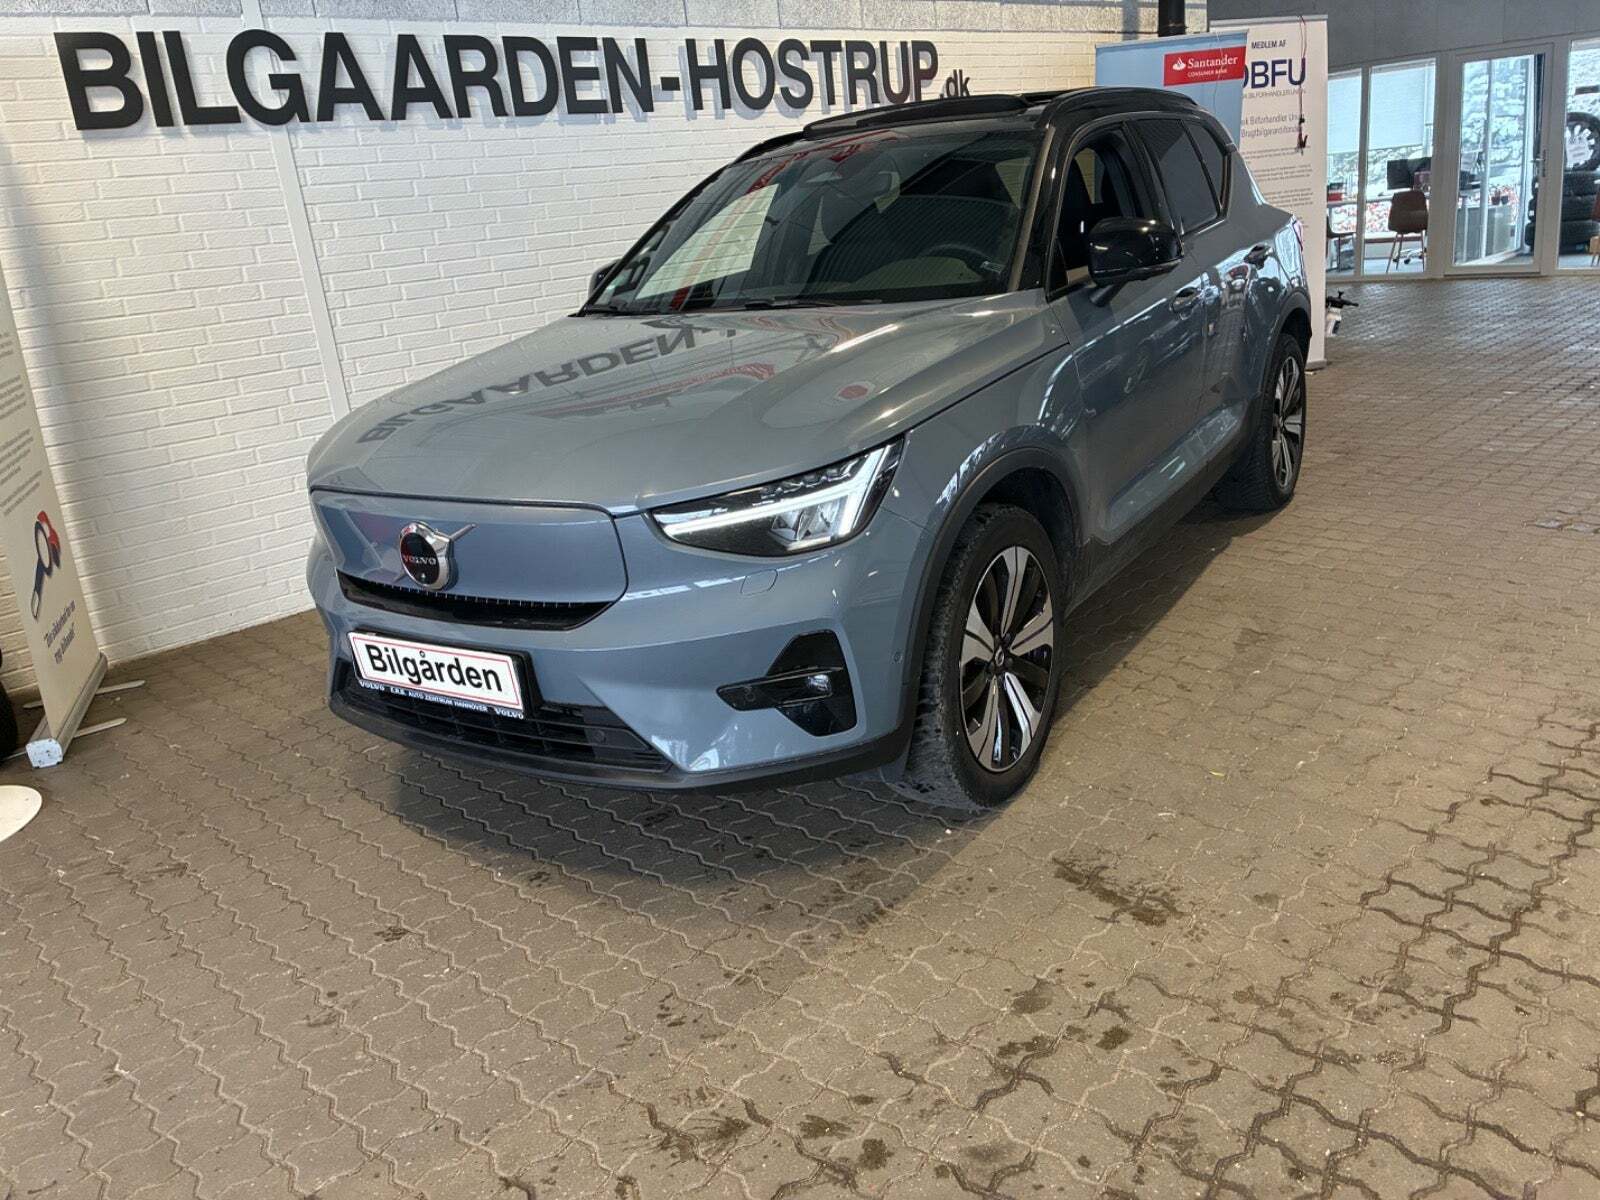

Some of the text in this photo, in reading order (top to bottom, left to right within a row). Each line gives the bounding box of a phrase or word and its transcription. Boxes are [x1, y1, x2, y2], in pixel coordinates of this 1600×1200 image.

[1251, 39, 1287, 49] MEDLEM AF
[1187, 54, 1239, 69] Santander
[1187, 70, 1214, 78] CONSUMER
[402, 554, 437, 565] VOLVO
[365, 644, 503, 692] Bilgården
[360, 681, 385, 691] VOLVO
[494, 707, 524, 720] VOLVO
